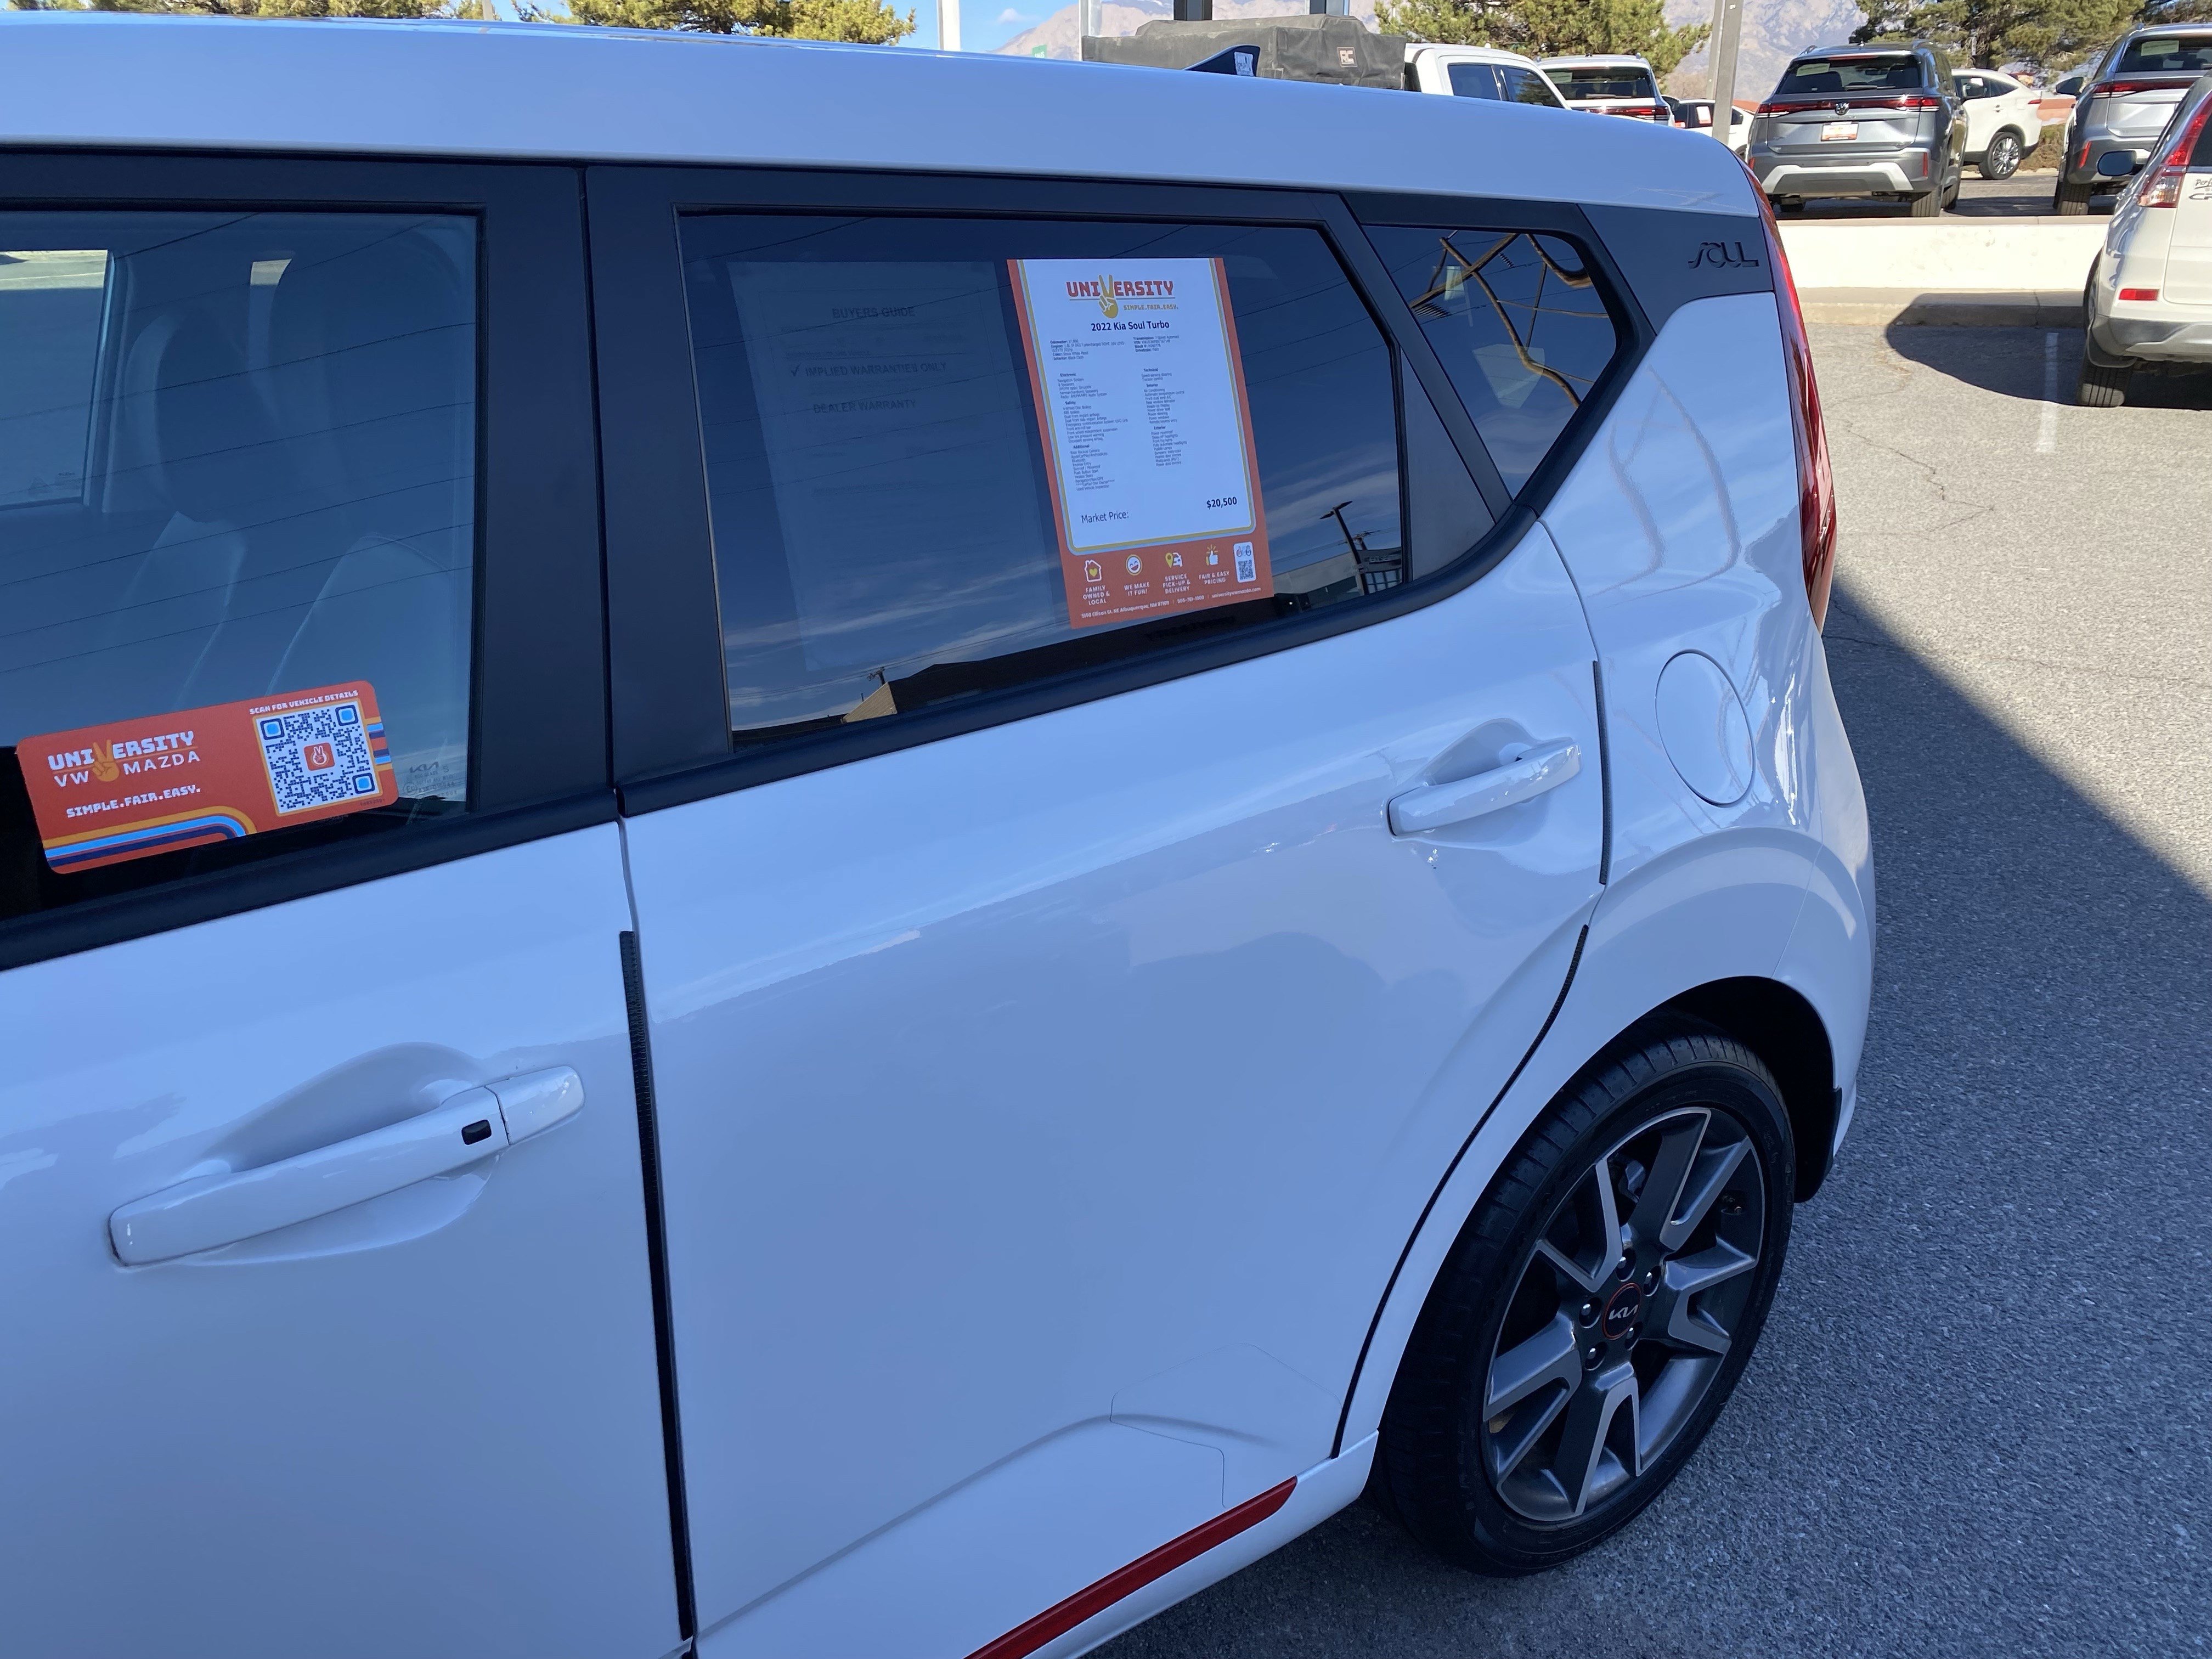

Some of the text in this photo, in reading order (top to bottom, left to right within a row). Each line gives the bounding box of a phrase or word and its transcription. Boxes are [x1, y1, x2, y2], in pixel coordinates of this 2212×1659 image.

[1688, 242, 1760, 269] SOUL
[1066, 278, 1174, 298] UNIVERSITY
[832, 307, 916, 319] BUYERS GUIDE
[1091, 323, 1111, 331] 2022
[1128, 321, 1144, 329] Soul
[1147, 320, 1169, 329] Turbo
[805, 362, 946, 377] IMPLIED WARRANTIES ONLY
[813, 399, 916, 414] DEALER WARRANTY
[1206, 496, 1237, 510] $20,500
[1081, 511, 1128, 523] Market Price:
[1165, 573, 1187, 582] SERVICE
[1082, 592, 1104, 600] OWNED
[1165, 585, 1190, 594] DELIVERY
[249, 690, 358, 714] SCAN FOR VEHICLE DETAILS
[48, 731, 194, 770] UNIVERSITY
[54, 751, 200, 787] VW MAZDA
[66, 785, 201, 818] SIMPLE.FAIR.EASY.
[1608, 1304, 1639, 1320] KIA
